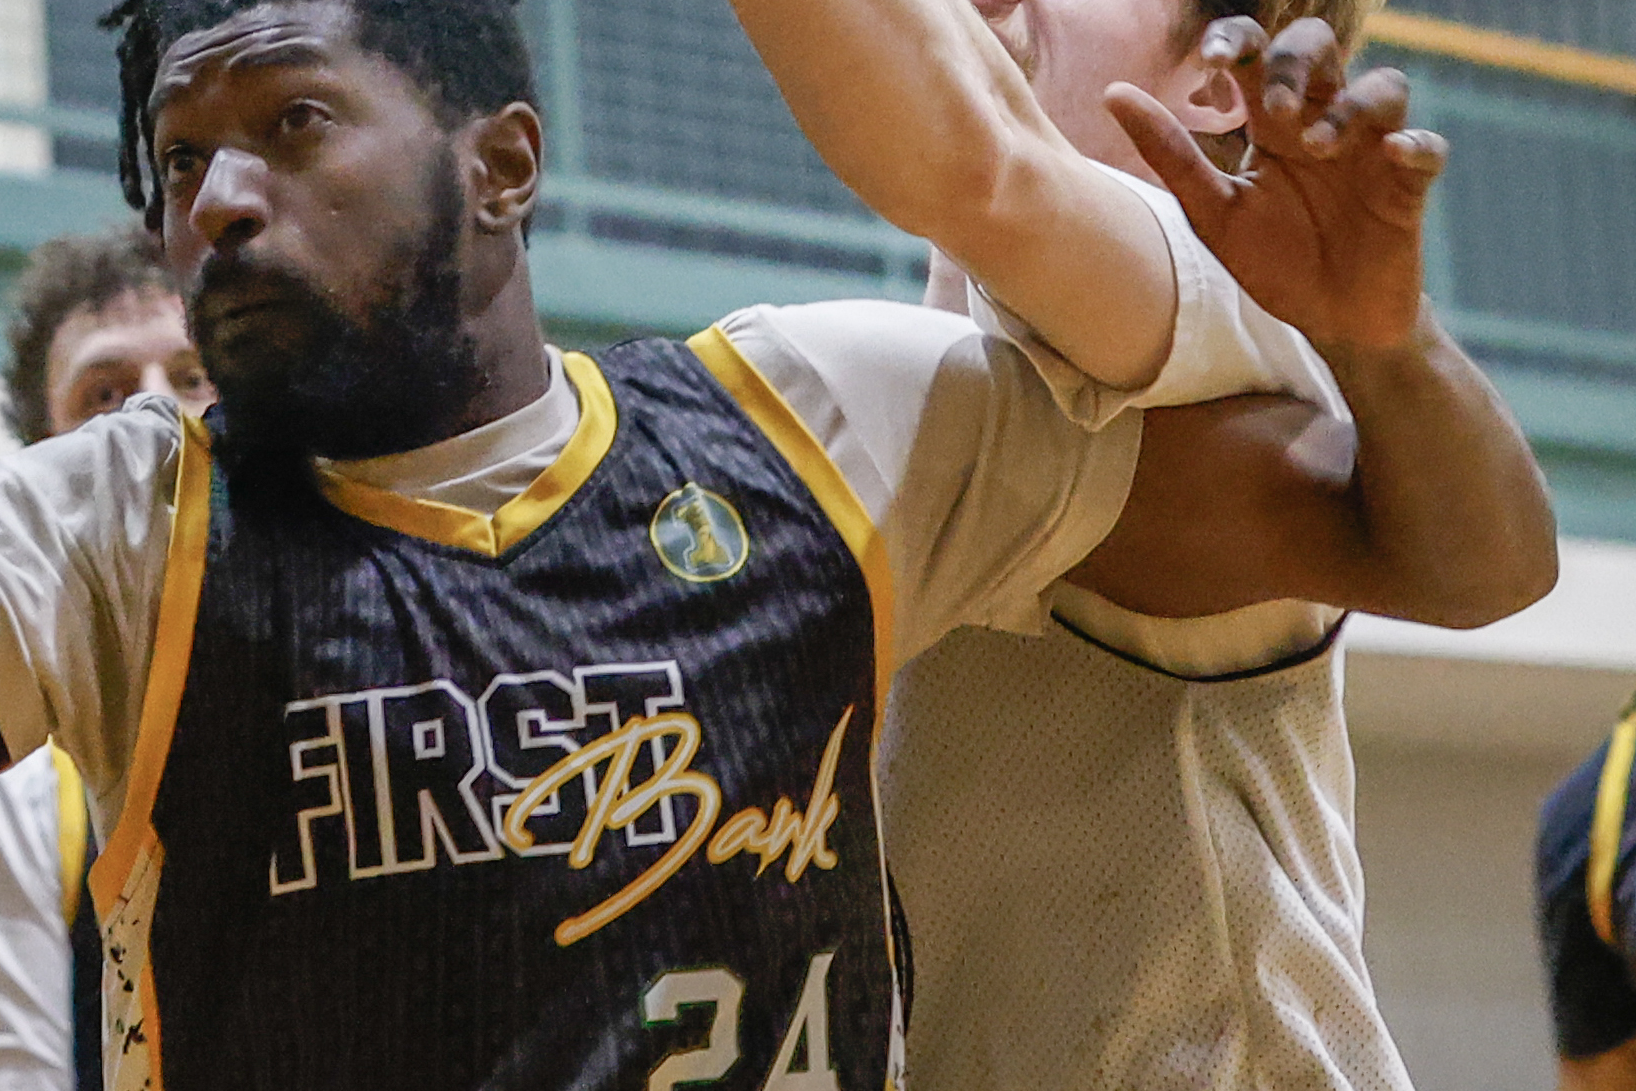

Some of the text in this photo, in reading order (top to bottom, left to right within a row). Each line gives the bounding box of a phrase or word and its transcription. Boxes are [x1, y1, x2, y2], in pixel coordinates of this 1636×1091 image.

[269, 659, 685, 897] FIRST
[500, 703, 855, 948] Bank
[642, 950, 842, 1091] 24
